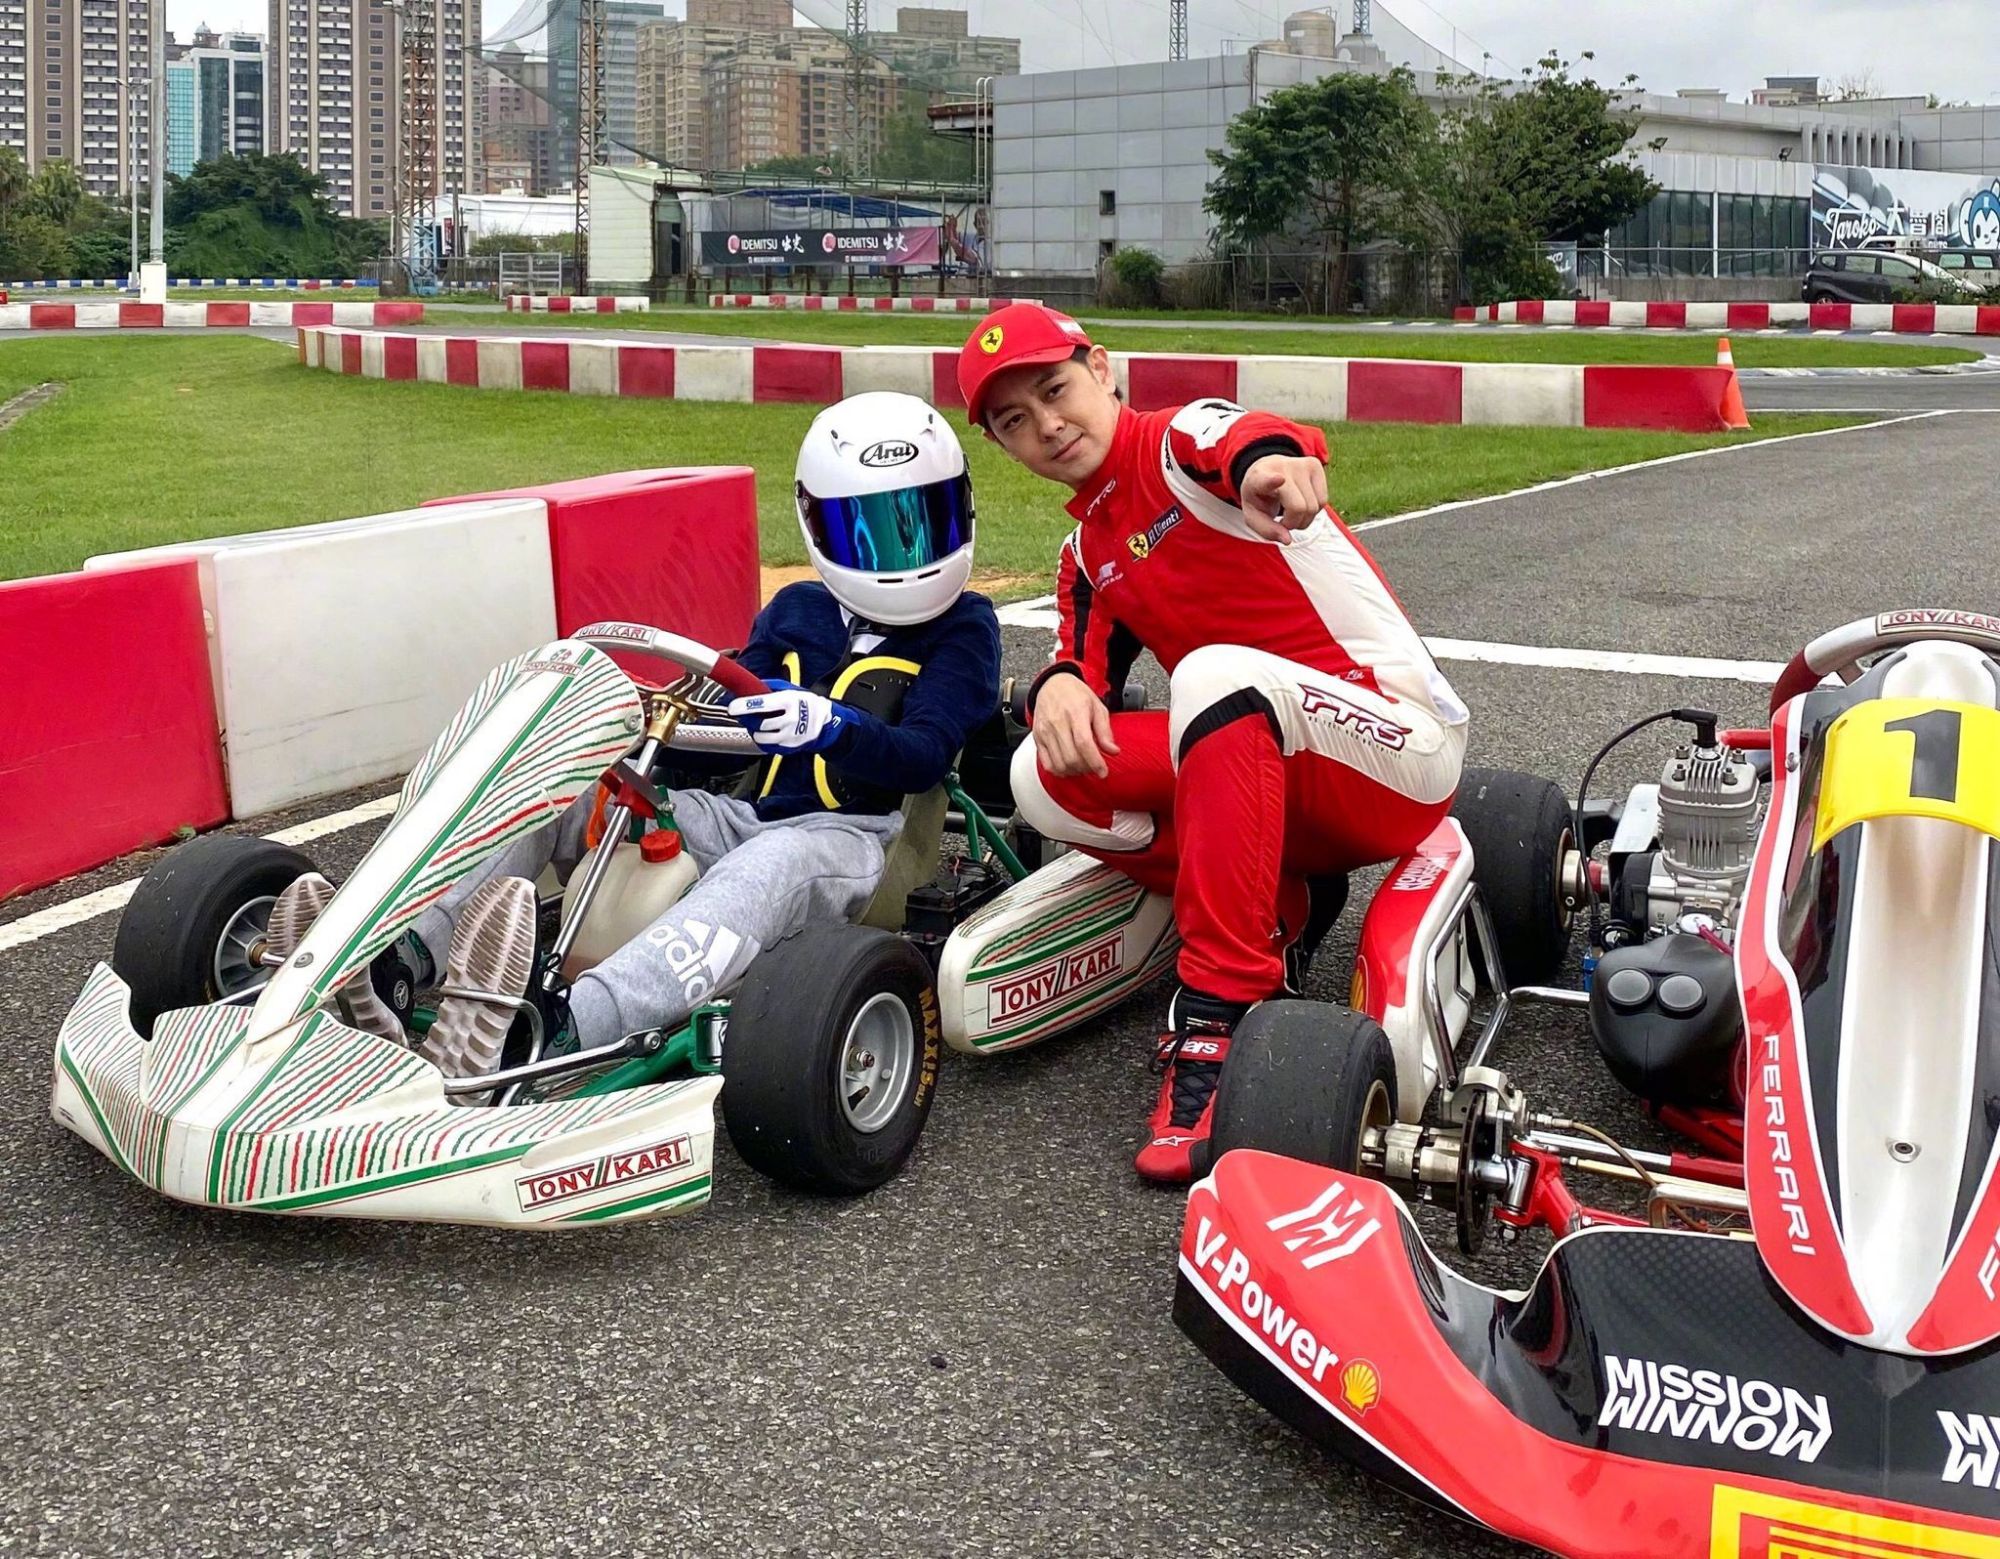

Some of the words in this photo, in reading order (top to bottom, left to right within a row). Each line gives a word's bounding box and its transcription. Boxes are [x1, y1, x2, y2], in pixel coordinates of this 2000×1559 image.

[741, 238, 778, 250] IDEMITSU
[837, 236, 878, 249] IDEMITSU
[865, 443, 911, 463] Arai
[1954, 611, 2000, 631] KAR
[746, 697, 765, 709] OMP
[799, 700, 809, 735] OMP
[1884, 709, 1962, 803] 1
[646, 925, 717, 1008] adid
[991, 966, 1057, 1014] TONY
[1068, 936, 1122, 985] KART
[519, 1163, 595, 1201] TONY
[611, 1140, 690, 1185] KART
[1763, 1033, 1816, 1256] FERRARI
[1193, 1216, 1339, 1383] V-Power
[1604, 1355, 1831, 1430] MISSION
[1598, 1394, 1832, 1463] WINNOW
